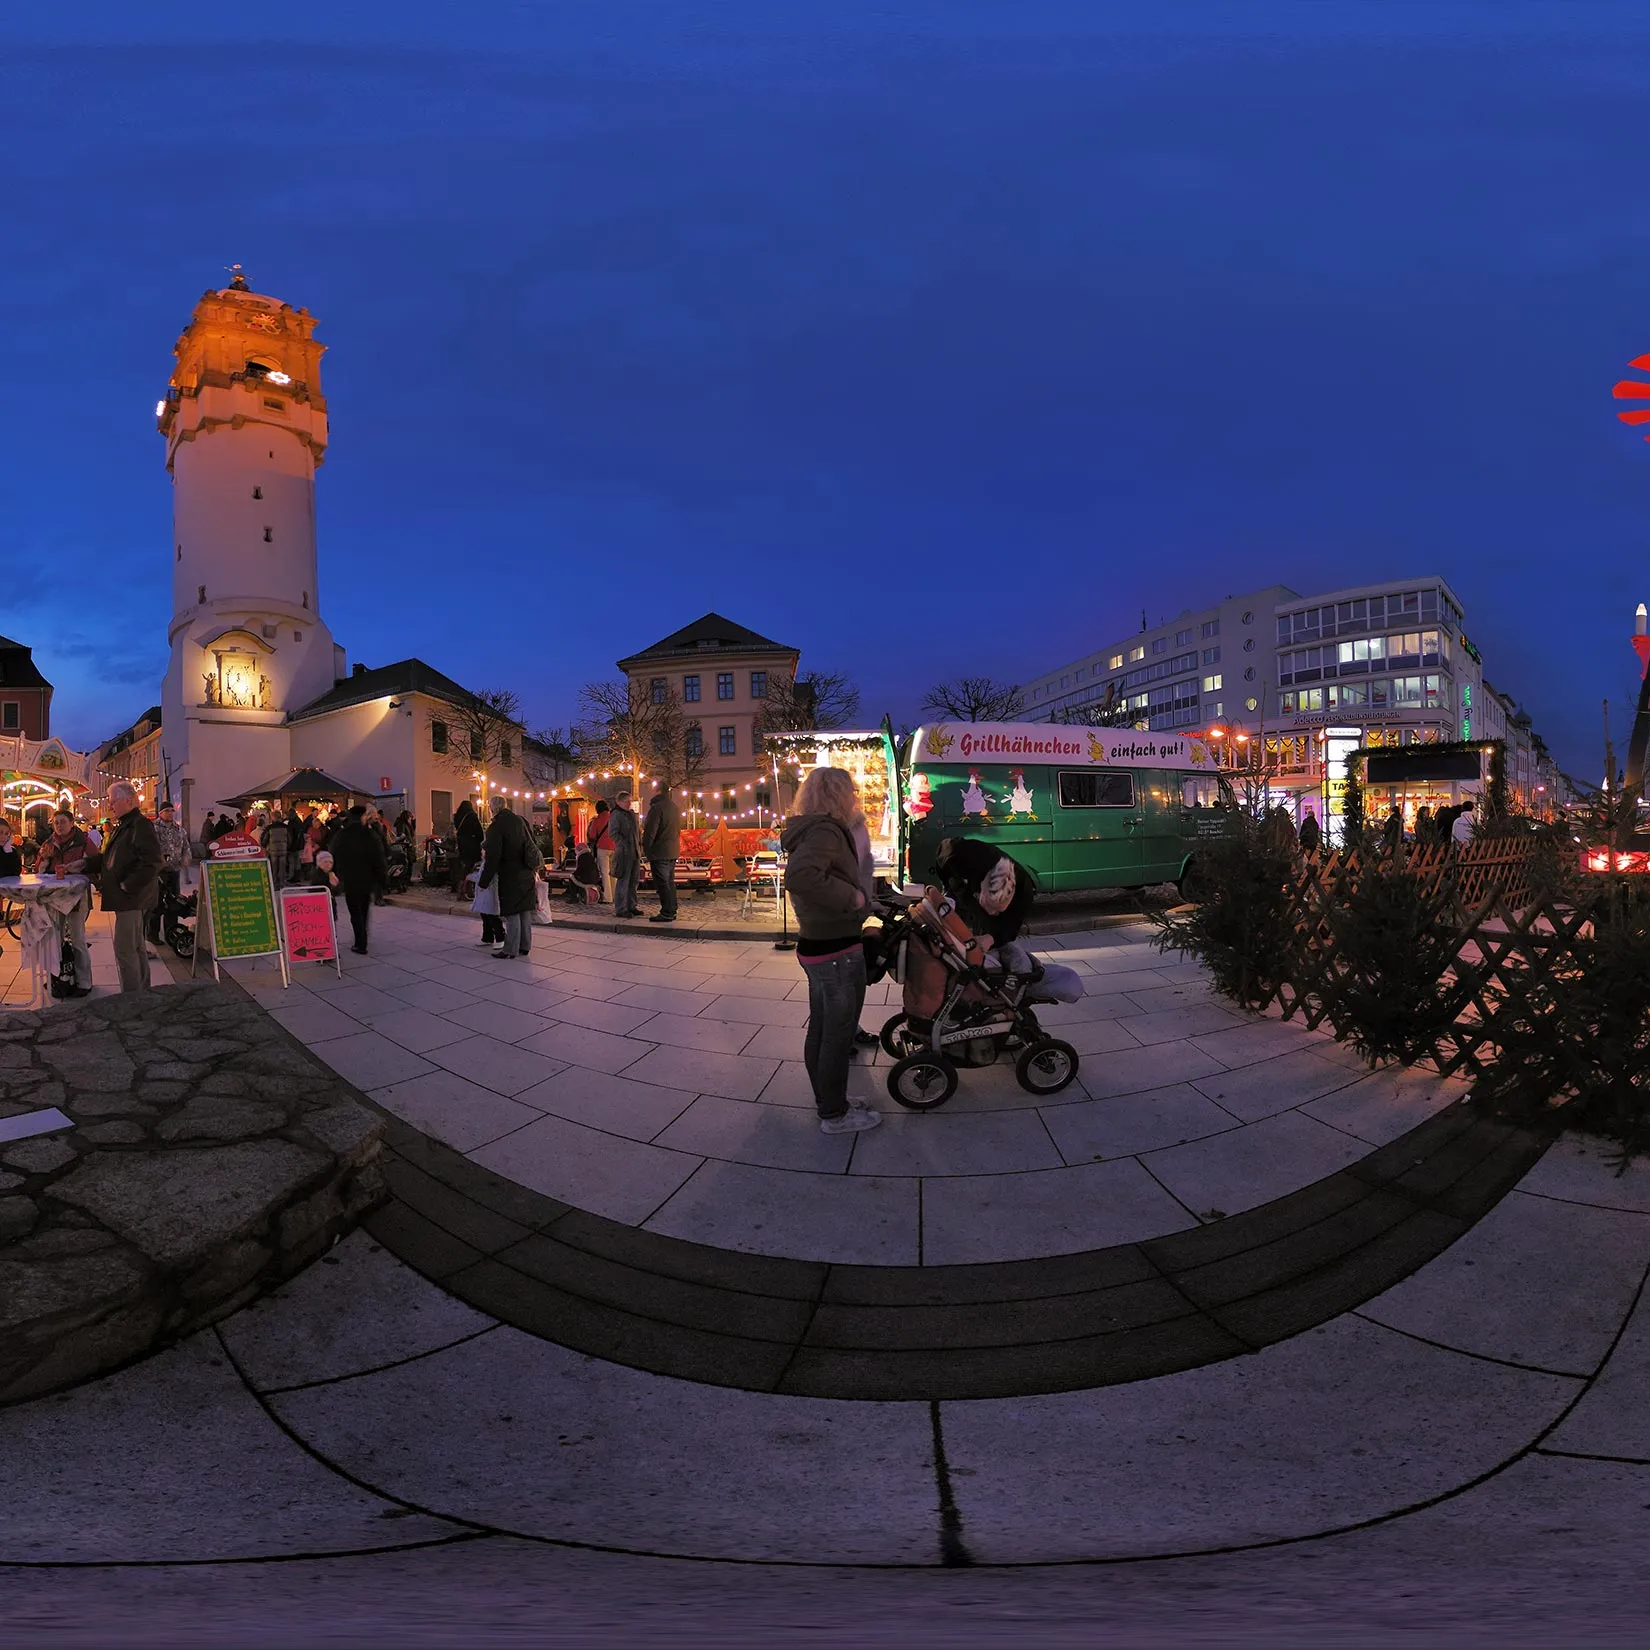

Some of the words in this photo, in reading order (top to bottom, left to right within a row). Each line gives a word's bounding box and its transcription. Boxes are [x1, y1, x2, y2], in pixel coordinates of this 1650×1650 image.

[1293, 716, 1324, 726] Adecco
[960, 733, 1081, 756] Grillhähnchen
[1111, 742, 1156, 760] einfach
[1160, 742, 1184, 759] gut!
